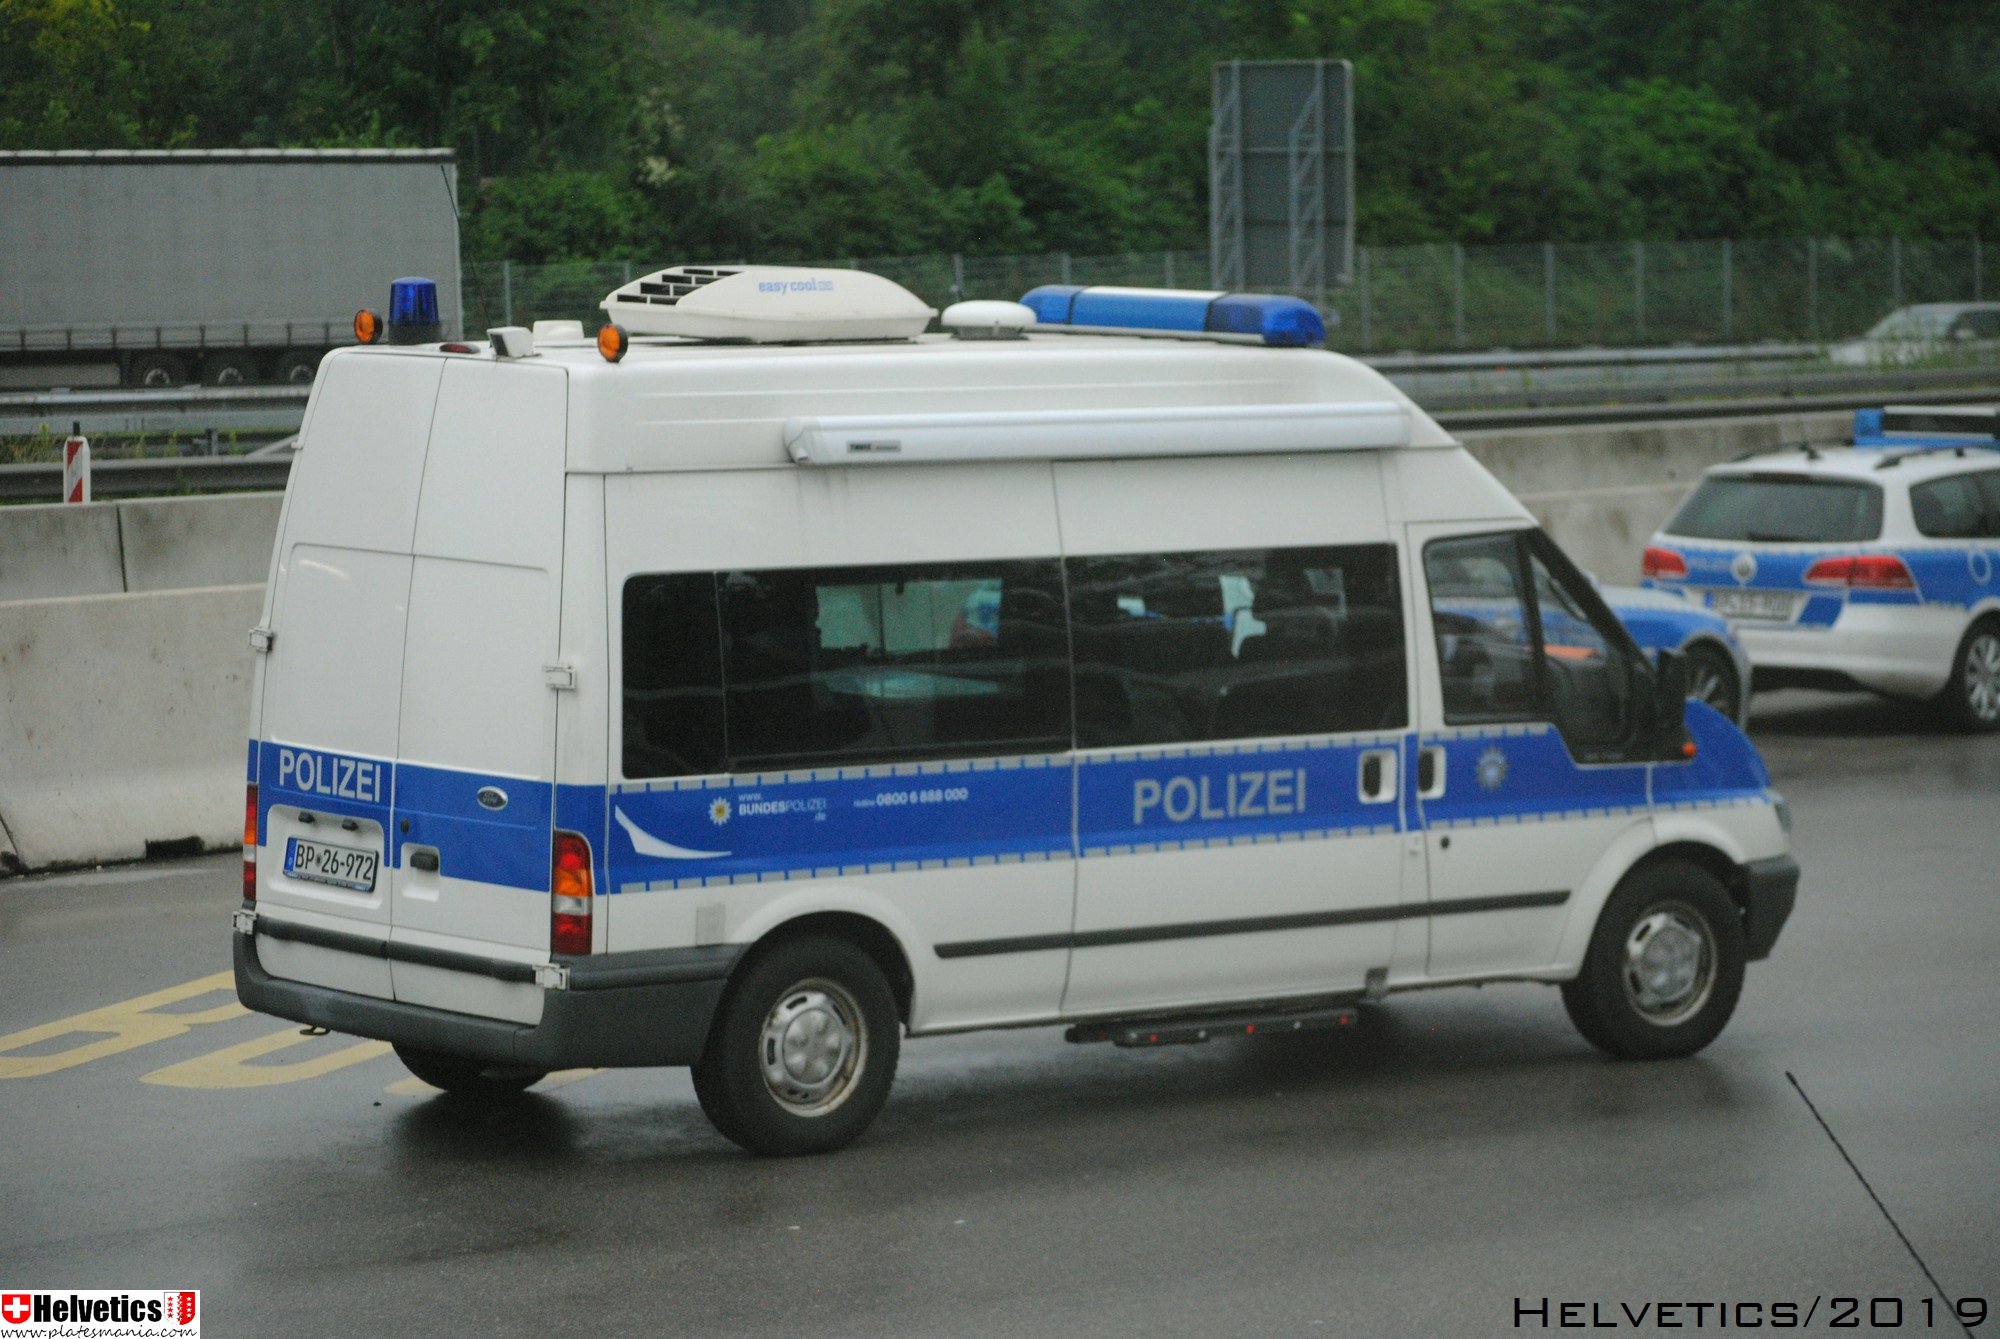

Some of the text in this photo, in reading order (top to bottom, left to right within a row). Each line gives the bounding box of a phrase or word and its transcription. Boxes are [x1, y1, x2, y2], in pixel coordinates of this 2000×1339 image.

[758, 281, 788, 296] easy
[790, 276, 817, 292] cool
[278, 749, 382, 803] POLIZEI
[876, 793, 908, 806] 0800
[1133, 768, 1306, 824] POLIZEI
[738, 798, 827, 816] BUNDESPOLIZEI
